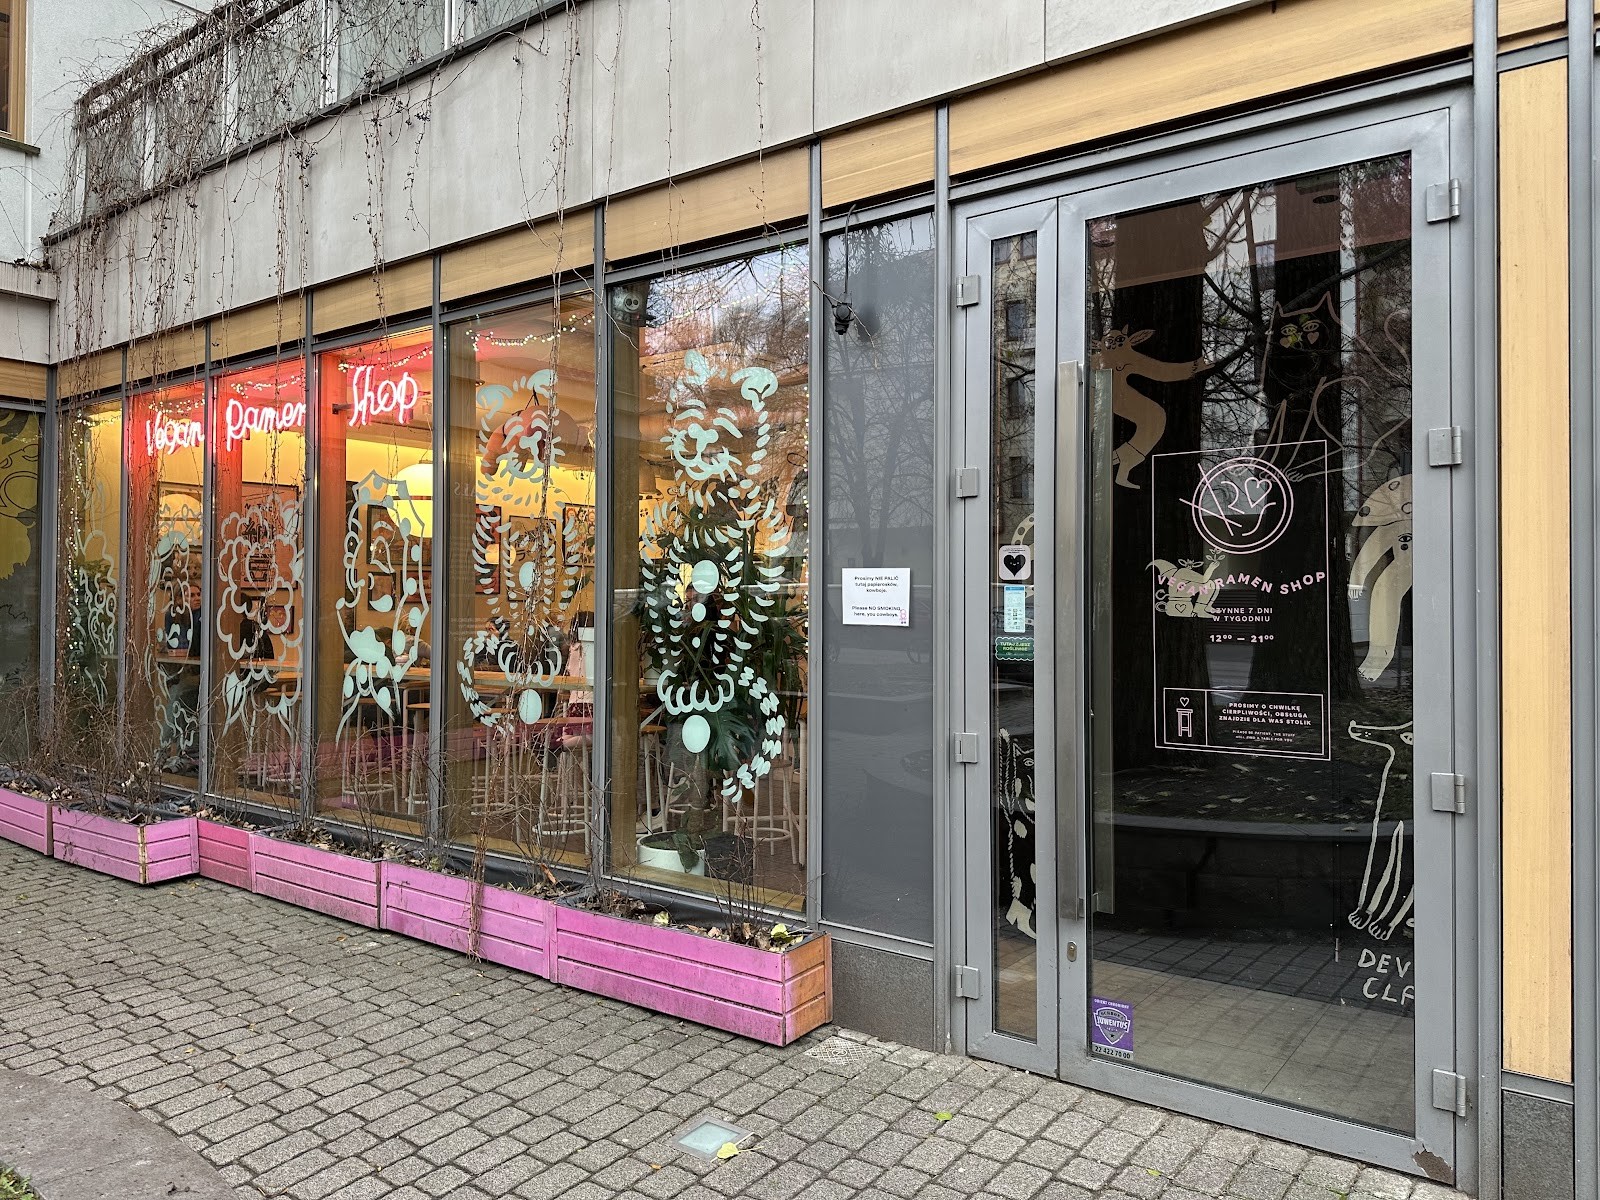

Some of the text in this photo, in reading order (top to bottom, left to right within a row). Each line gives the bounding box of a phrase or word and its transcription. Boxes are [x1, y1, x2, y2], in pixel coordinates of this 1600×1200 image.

[145, 411, 205, 457] Vegan
[348, 365, 419, 427] Shop
[1156, 571, 1327, 597] VEGAN RAMEN SHOP
[1222, 708, 1273, 717] CIERPLIWOŚCI,
[1096, 1016, 1128, 1029] JUWENTUS
